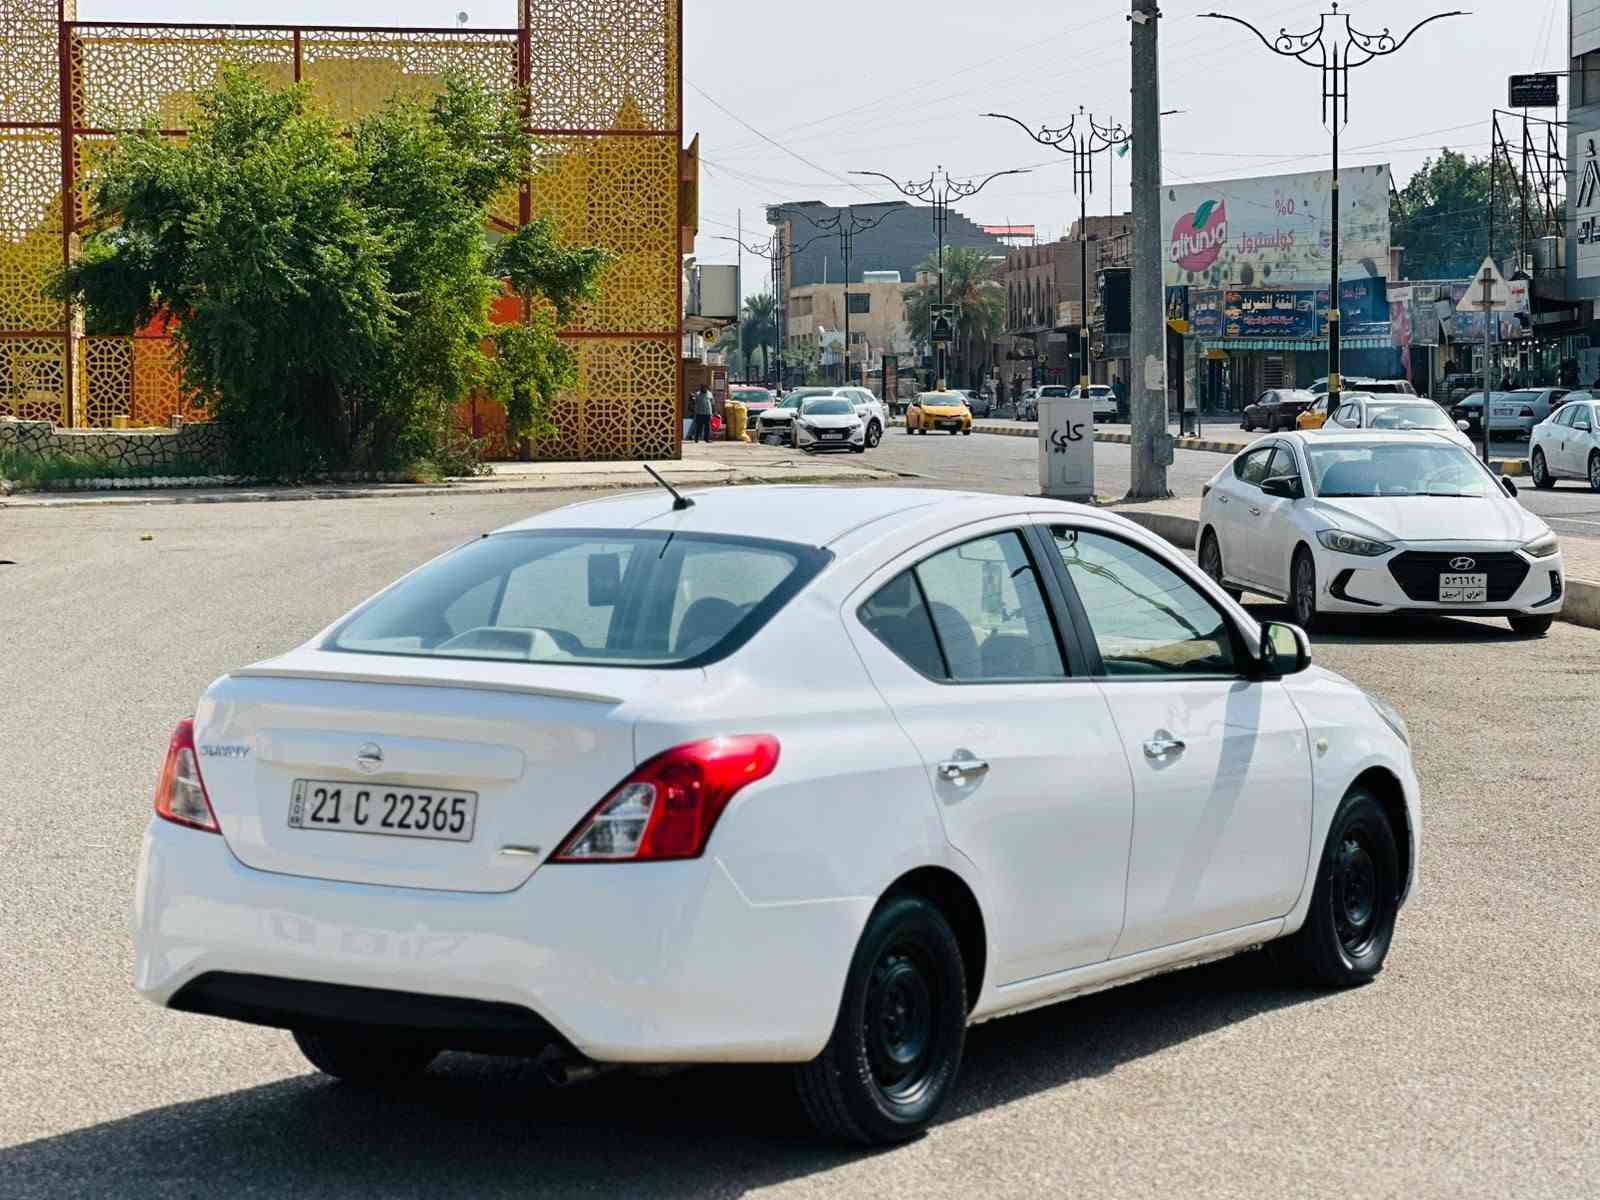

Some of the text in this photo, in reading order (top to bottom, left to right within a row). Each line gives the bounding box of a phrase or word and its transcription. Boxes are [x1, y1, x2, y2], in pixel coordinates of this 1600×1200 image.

[311, 788, 467, 834] 21 C 22365
